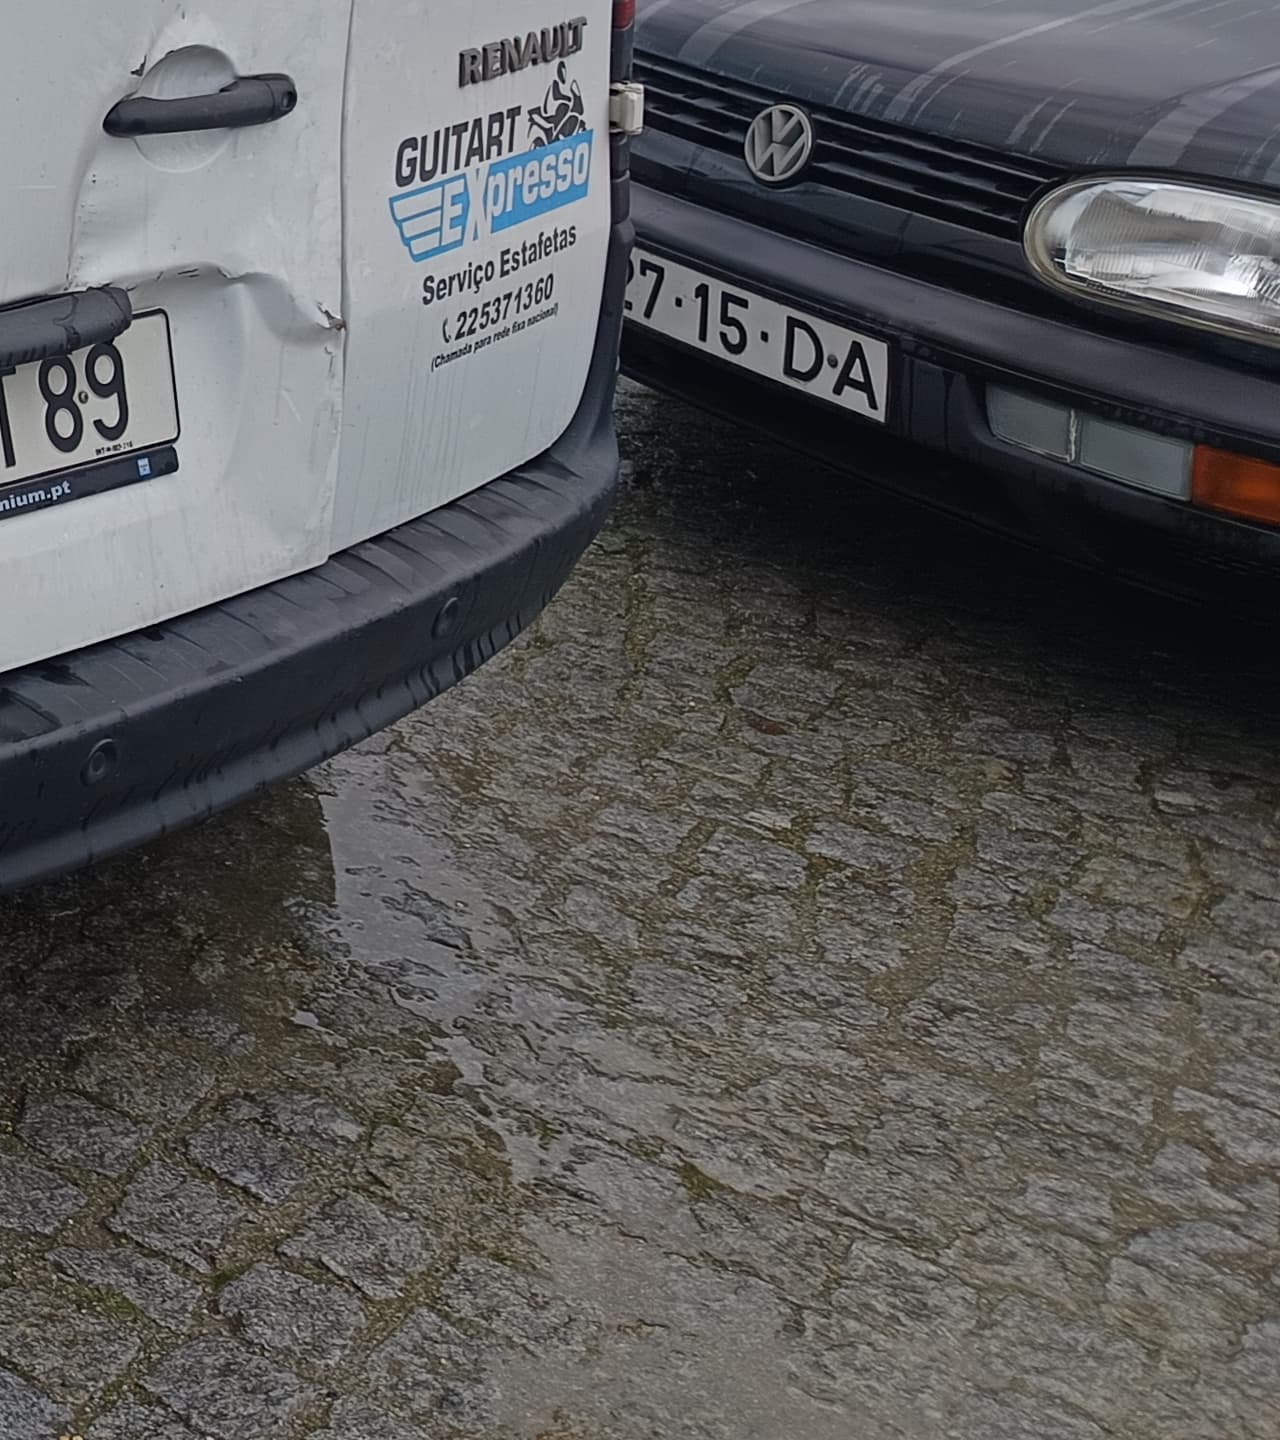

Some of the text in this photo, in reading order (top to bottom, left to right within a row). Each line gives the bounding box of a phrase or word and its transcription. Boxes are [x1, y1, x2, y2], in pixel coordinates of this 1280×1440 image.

[458, 16, 588, 89] RENAULT
[395, 105, 522, 188] GUITART
[422, 225, 577, 305] Serviço Estafetas
[454, 273, 554, 341] 225371360
